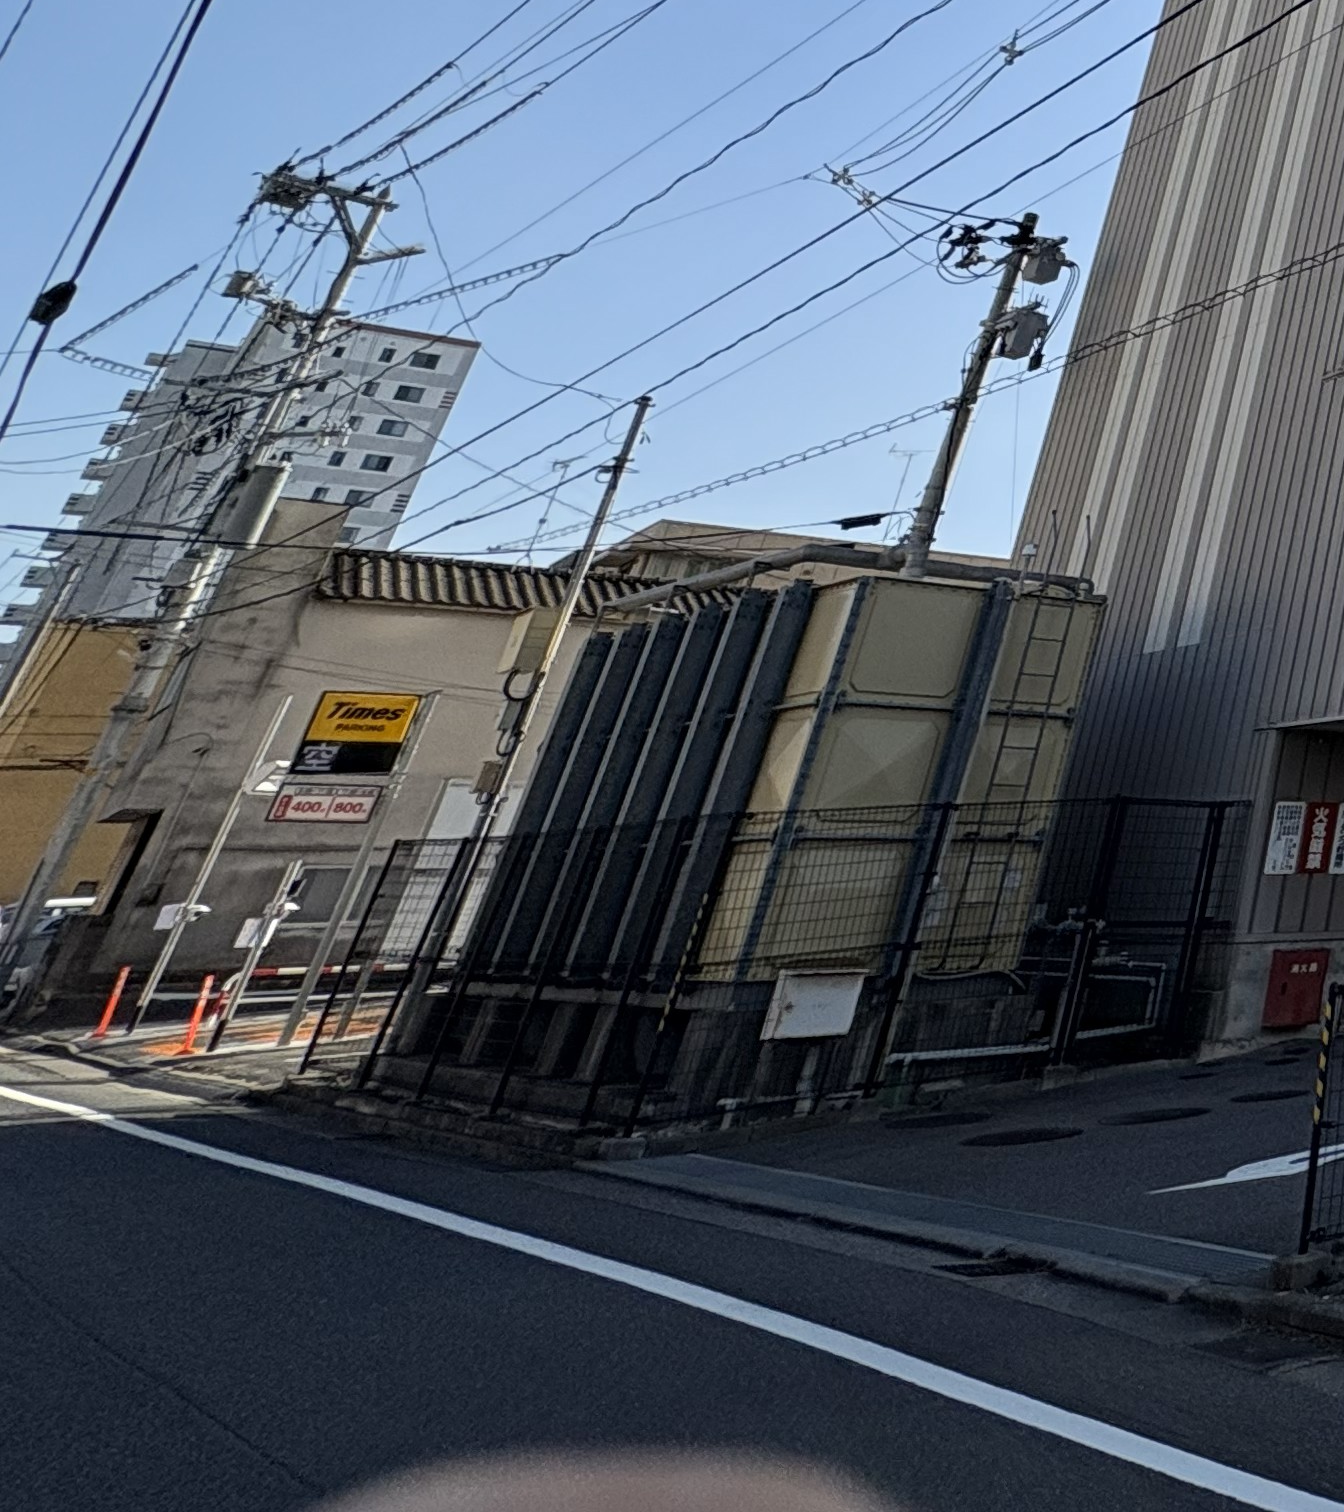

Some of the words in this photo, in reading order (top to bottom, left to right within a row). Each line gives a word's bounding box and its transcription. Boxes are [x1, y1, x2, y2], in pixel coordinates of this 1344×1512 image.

[328, 702, 405, 720] Times
[334, 723, 386, 733] PARKING
[295, 743, 340, 771] 空
